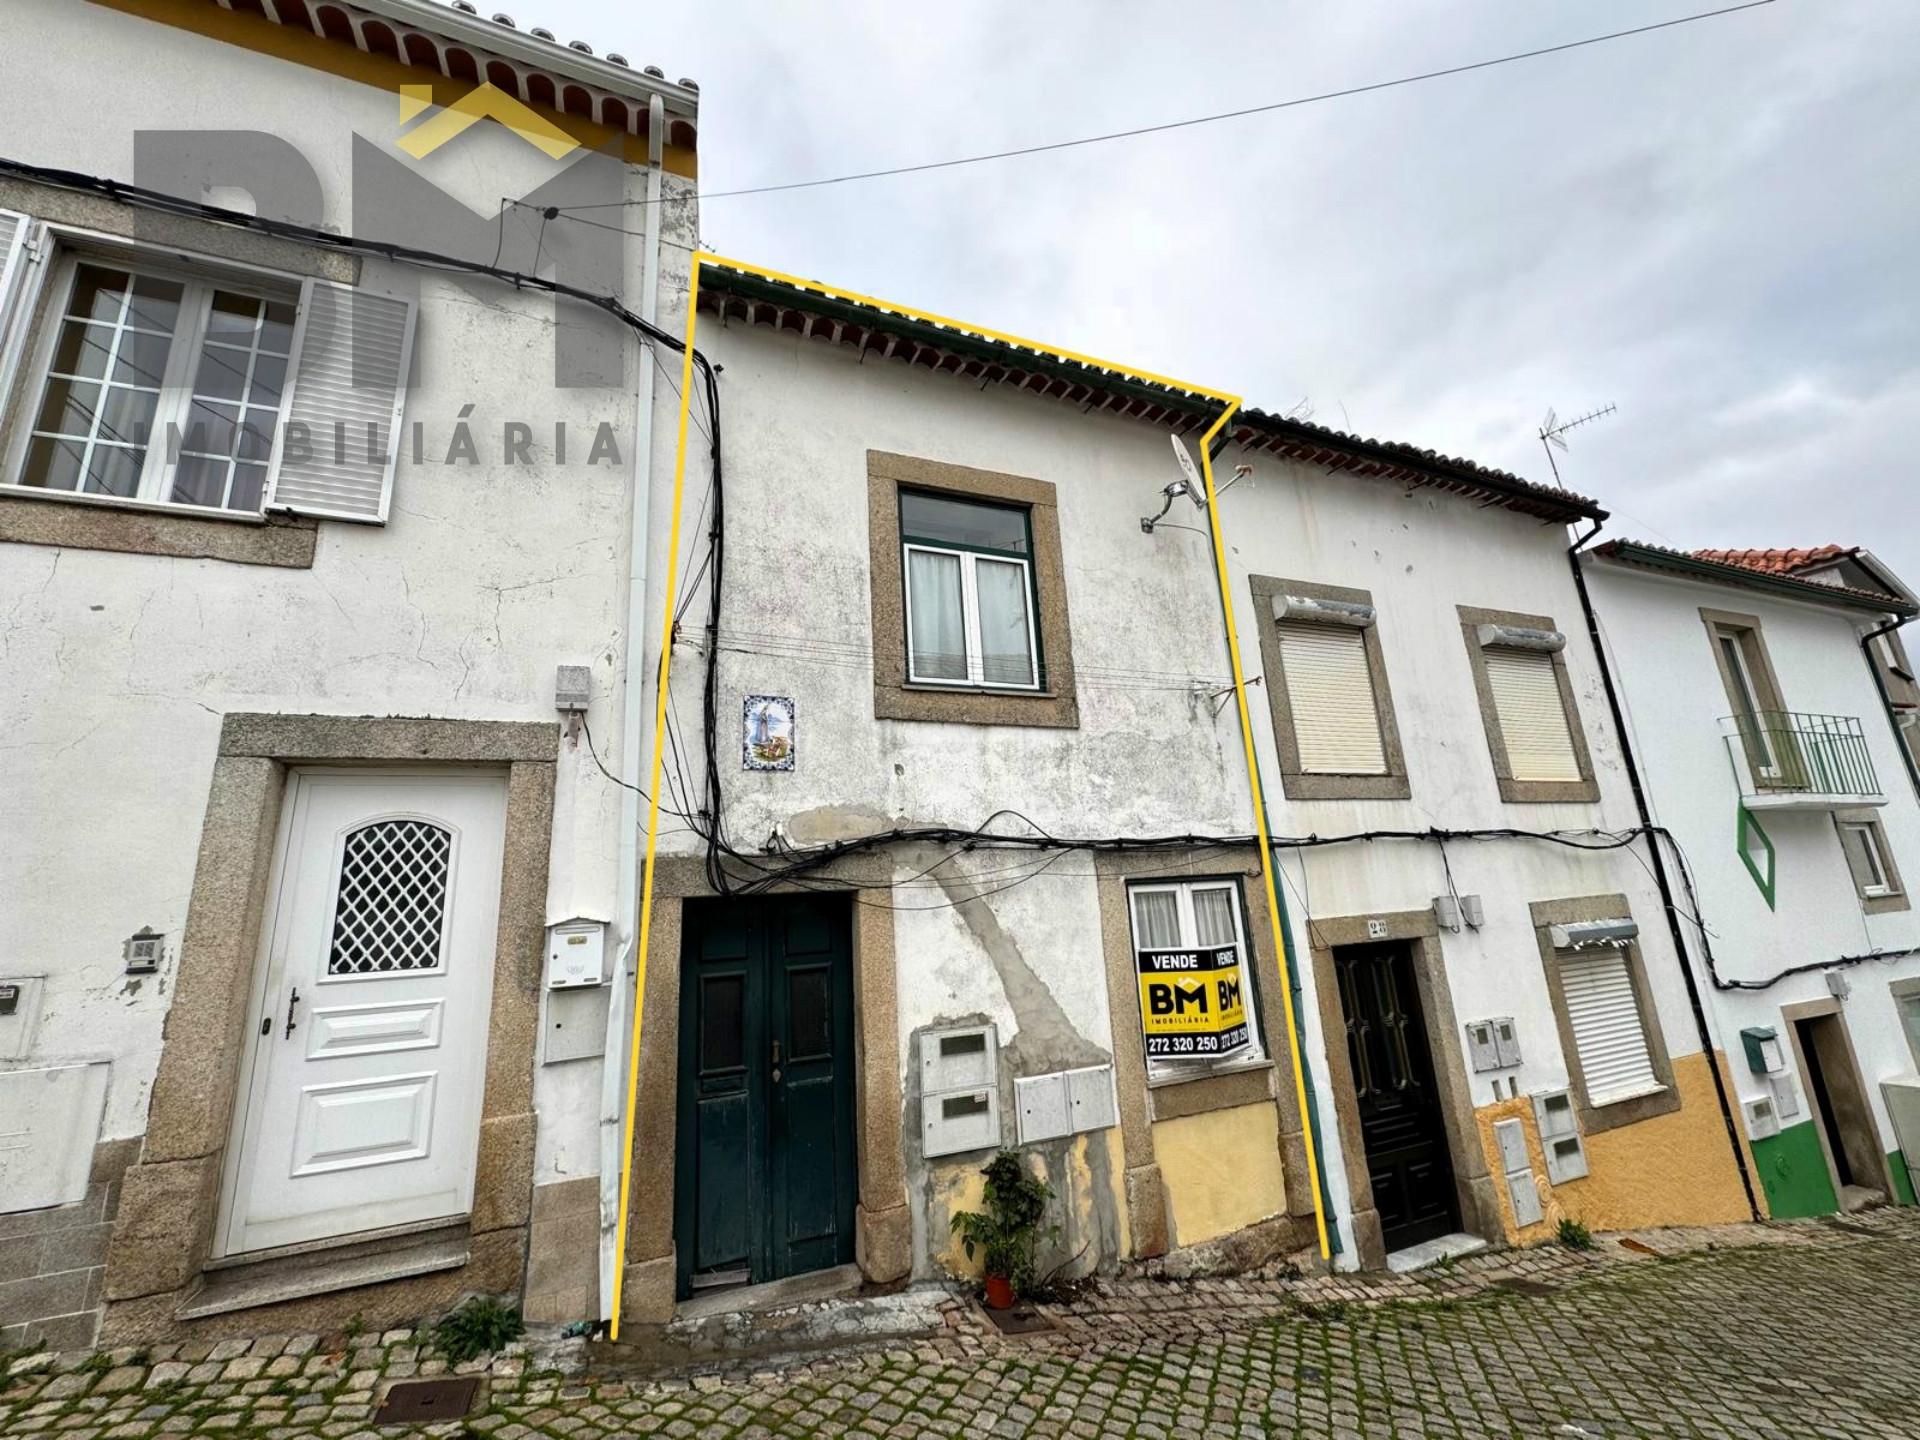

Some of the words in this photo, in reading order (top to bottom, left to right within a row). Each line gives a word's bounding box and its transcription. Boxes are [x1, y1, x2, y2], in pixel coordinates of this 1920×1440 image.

[1152, 954, 1198, 969] VENDE
[1217, 951, 1235, 966] VENDE
[1149, 983, 1208, 1015] BM
[1217, 977, 1242, 1011] BM
[1152, 1016, 1209, 1025] IMOBILIÁRIA
[1149, 1037, 1170, 1052] 272
[1172, 1037, 1194, 1051] 320
[1196, 1036, 1218, 1050] 250
